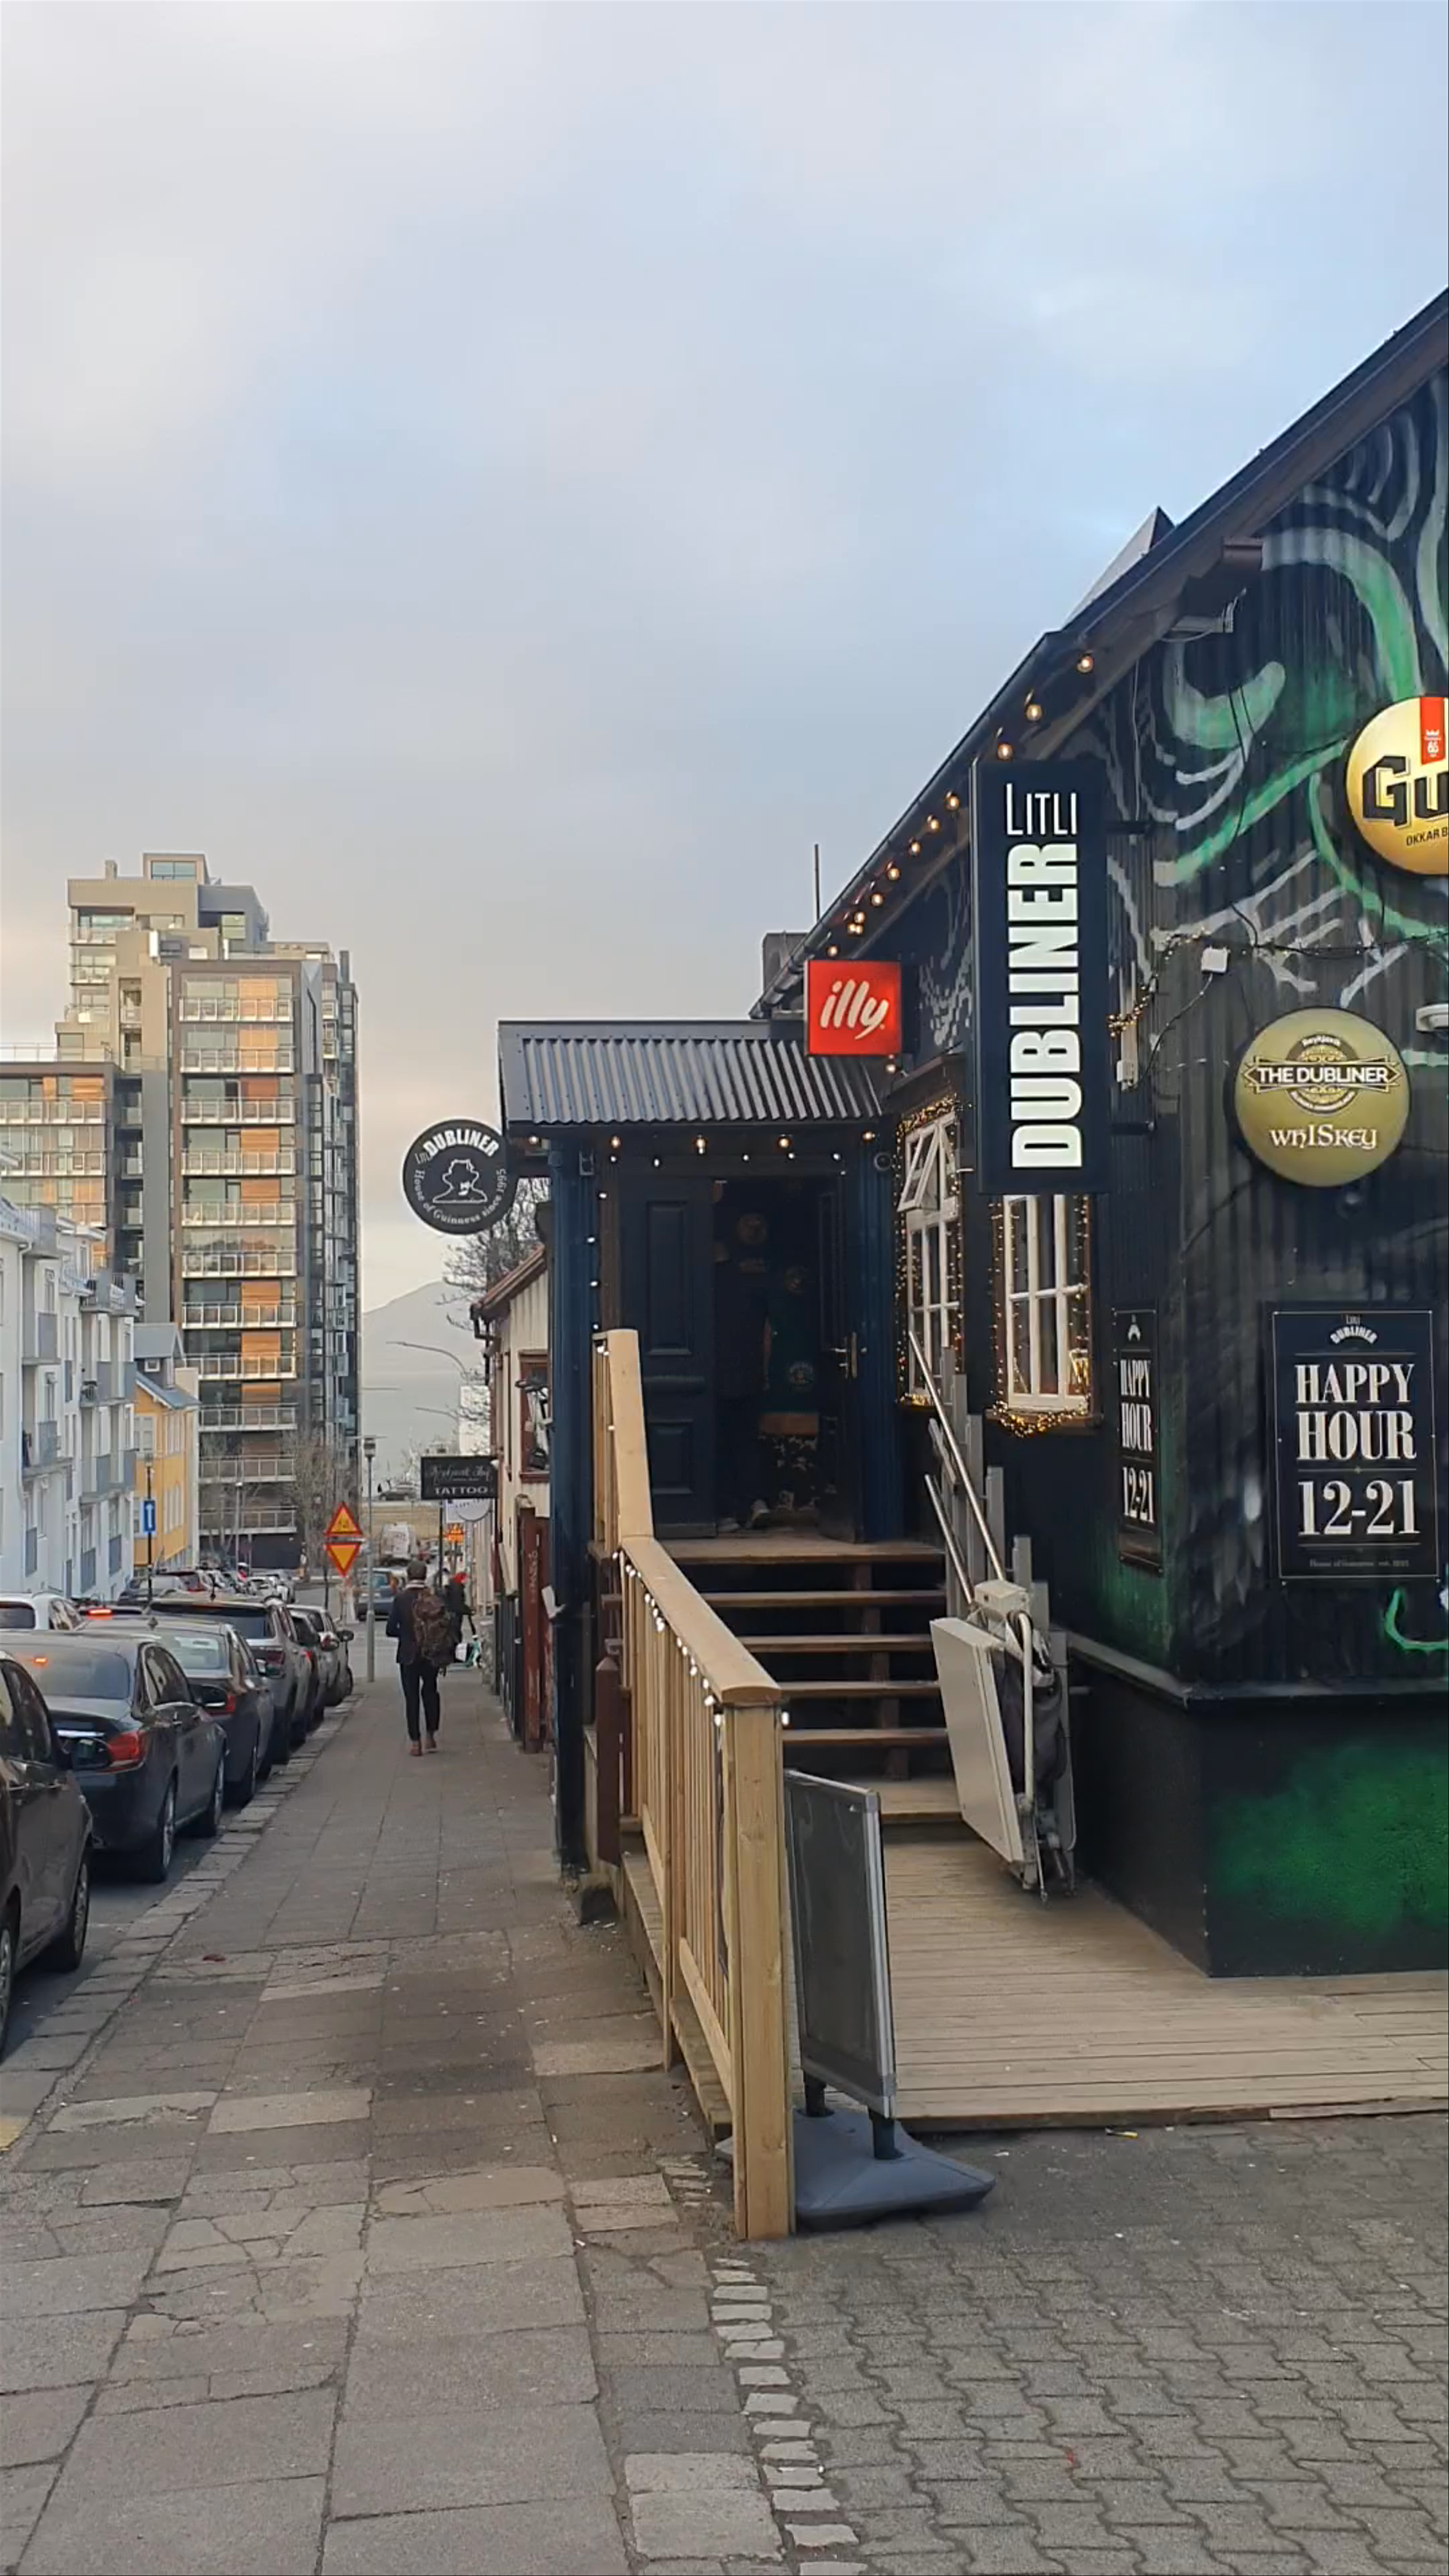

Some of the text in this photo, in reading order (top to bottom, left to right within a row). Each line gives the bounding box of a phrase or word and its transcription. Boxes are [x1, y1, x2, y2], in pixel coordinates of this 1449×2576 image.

[1406, 829, 1440, 846] OKKAR
[820, 979, 889, 1040] illy
[1008, 843, 1083, 1168] DUBLINER
[1257, 1067, 1389, 1083] THE DUBLINER
[423, 1129, 499, 1157] DUBLINER
[423, 1202, 436, 1212] of
[434, 1209, 481, 1224] Guinness
[1330, 1325, 1377, 1344] DUBLINER
[1120, 1359, 1151, 1398] HAPPY
[1295, 1363, 1415, 1404] HAPPY
[1121, 1403, 1152, 1451] HOUR
[1296, 1410, 1417, 1460] HOUR
[435, 1486, 488, 1495] TATTOO
[1123, 1467, 1154, 1523] 12-21
[1298, 1479, 1420, 1536] 12-21
